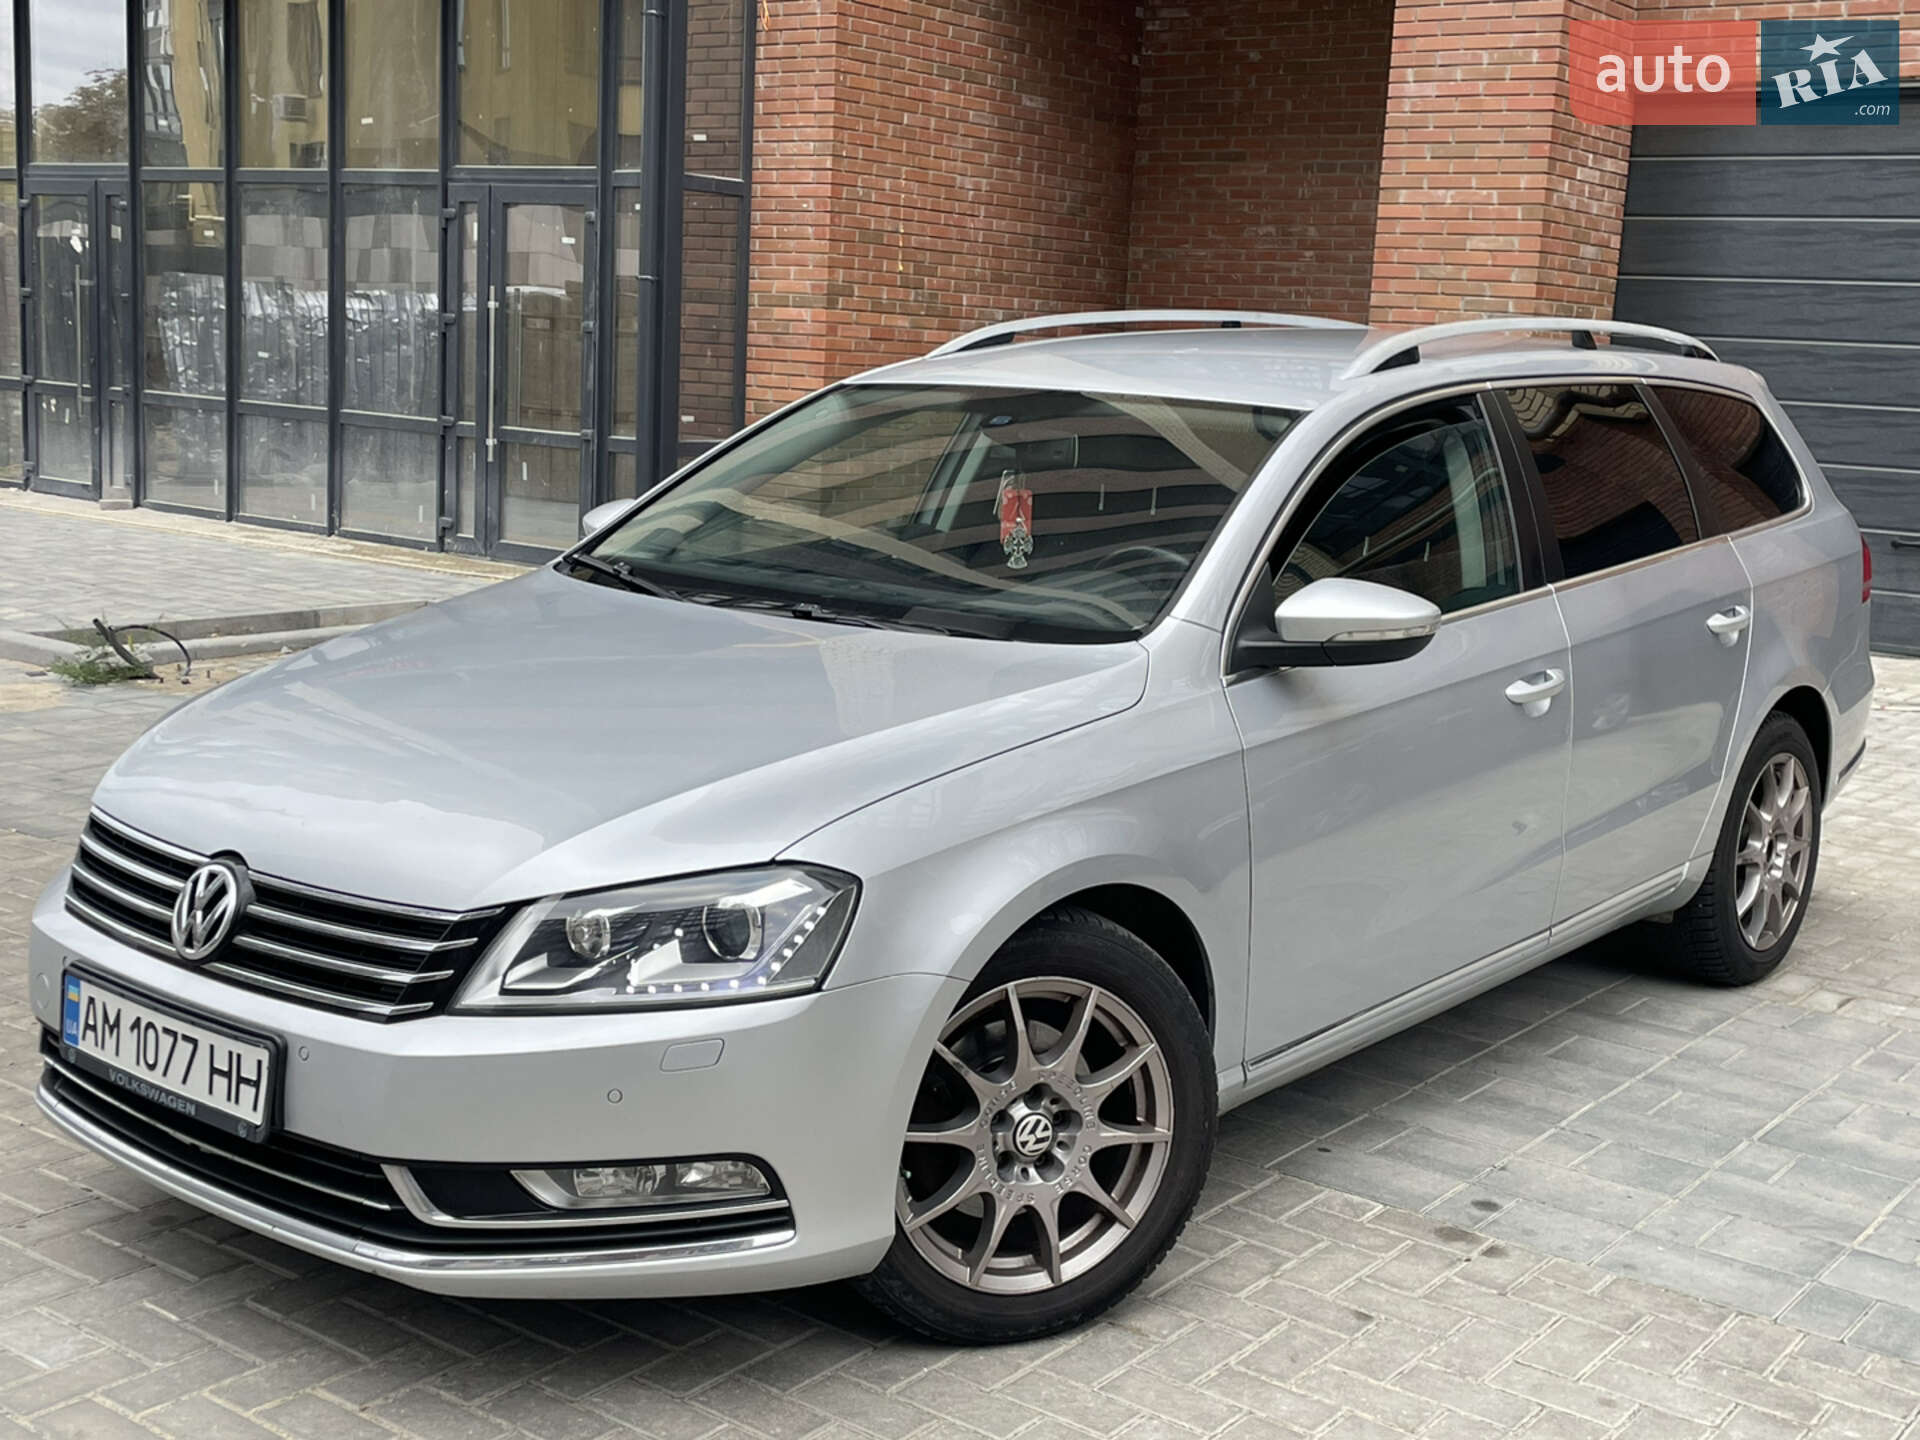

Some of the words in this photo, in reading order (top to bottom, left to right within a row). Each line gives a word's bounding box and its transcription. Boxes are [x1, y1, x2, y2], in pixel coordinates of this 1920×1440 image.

[82, 995, 122, 1057] AM
[129, 1016, 199, 1085] 1077
[208, 1043, 262, 1112] HH
[108, 1069, 196, 1115] VOLKSWAGEN
[1054, 1144, 1093, 1195] CORSE
